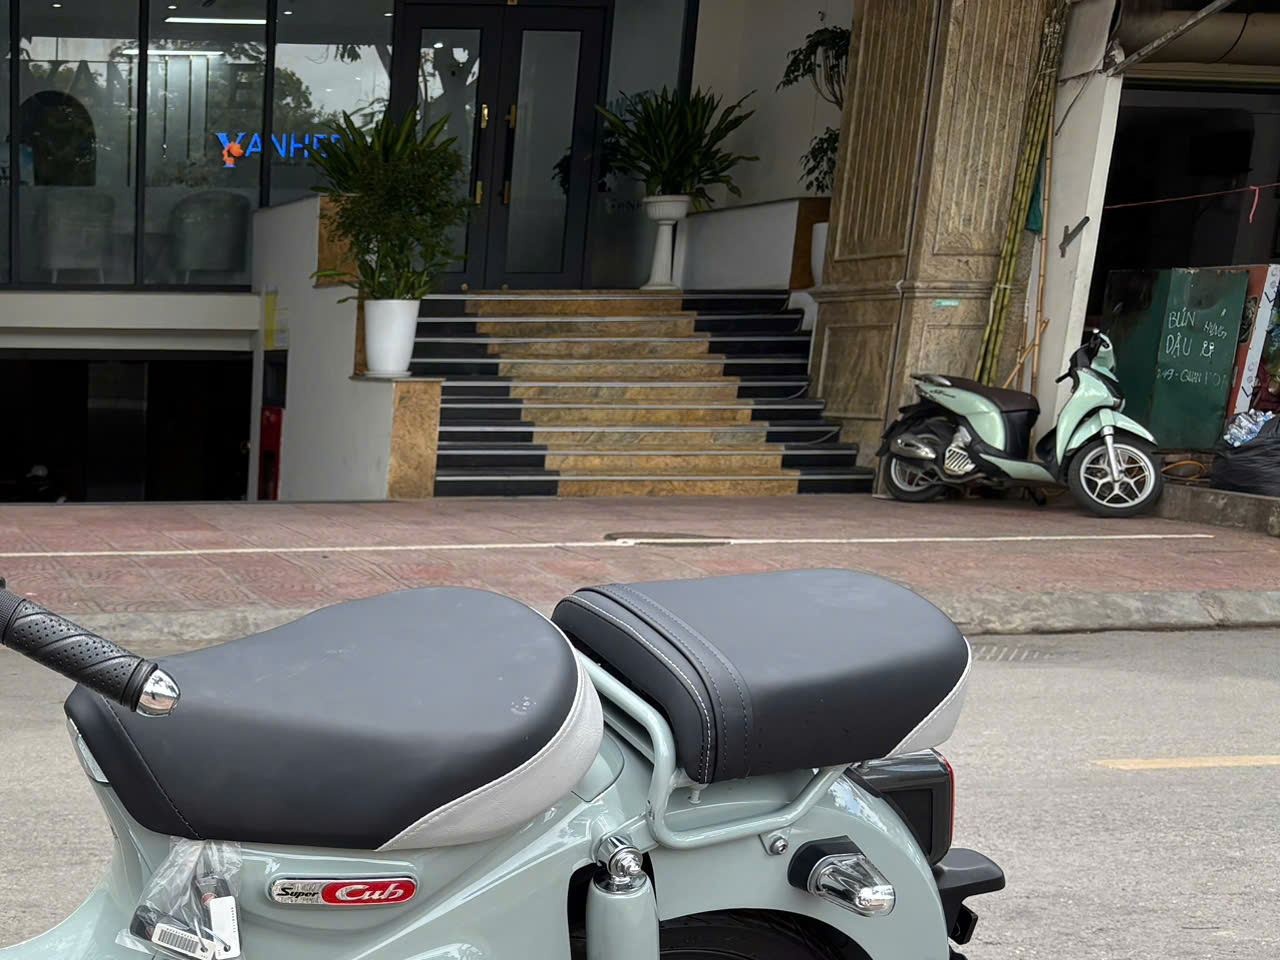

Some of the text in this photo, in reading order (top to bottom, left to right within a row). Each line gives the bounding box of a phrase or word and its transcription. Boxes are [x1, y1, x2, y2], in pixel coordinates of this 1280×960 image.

[1168, 307, 1196, 329] BÚN
[276, 882, 404, 901] Super Cub
